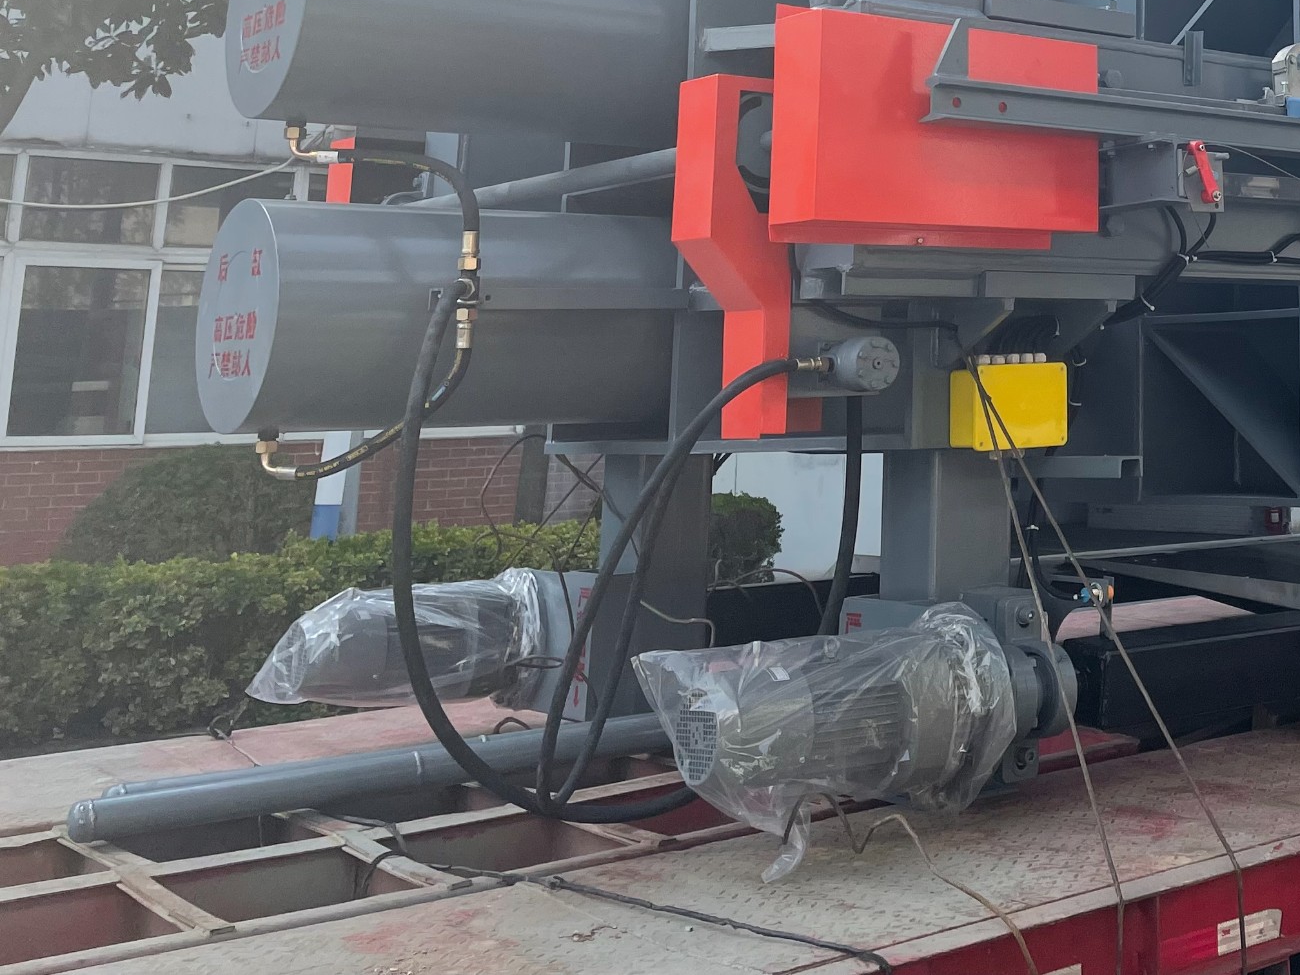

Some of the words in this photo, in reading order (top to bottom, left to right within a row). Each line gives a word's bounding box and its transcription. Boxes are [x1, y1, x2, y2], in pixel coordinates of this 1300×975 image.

[238, 35, 281, 75] 严禁站人
[213, 311, 257, 343] 高压危险
[208, 349, 251, 379] 严禁站人
